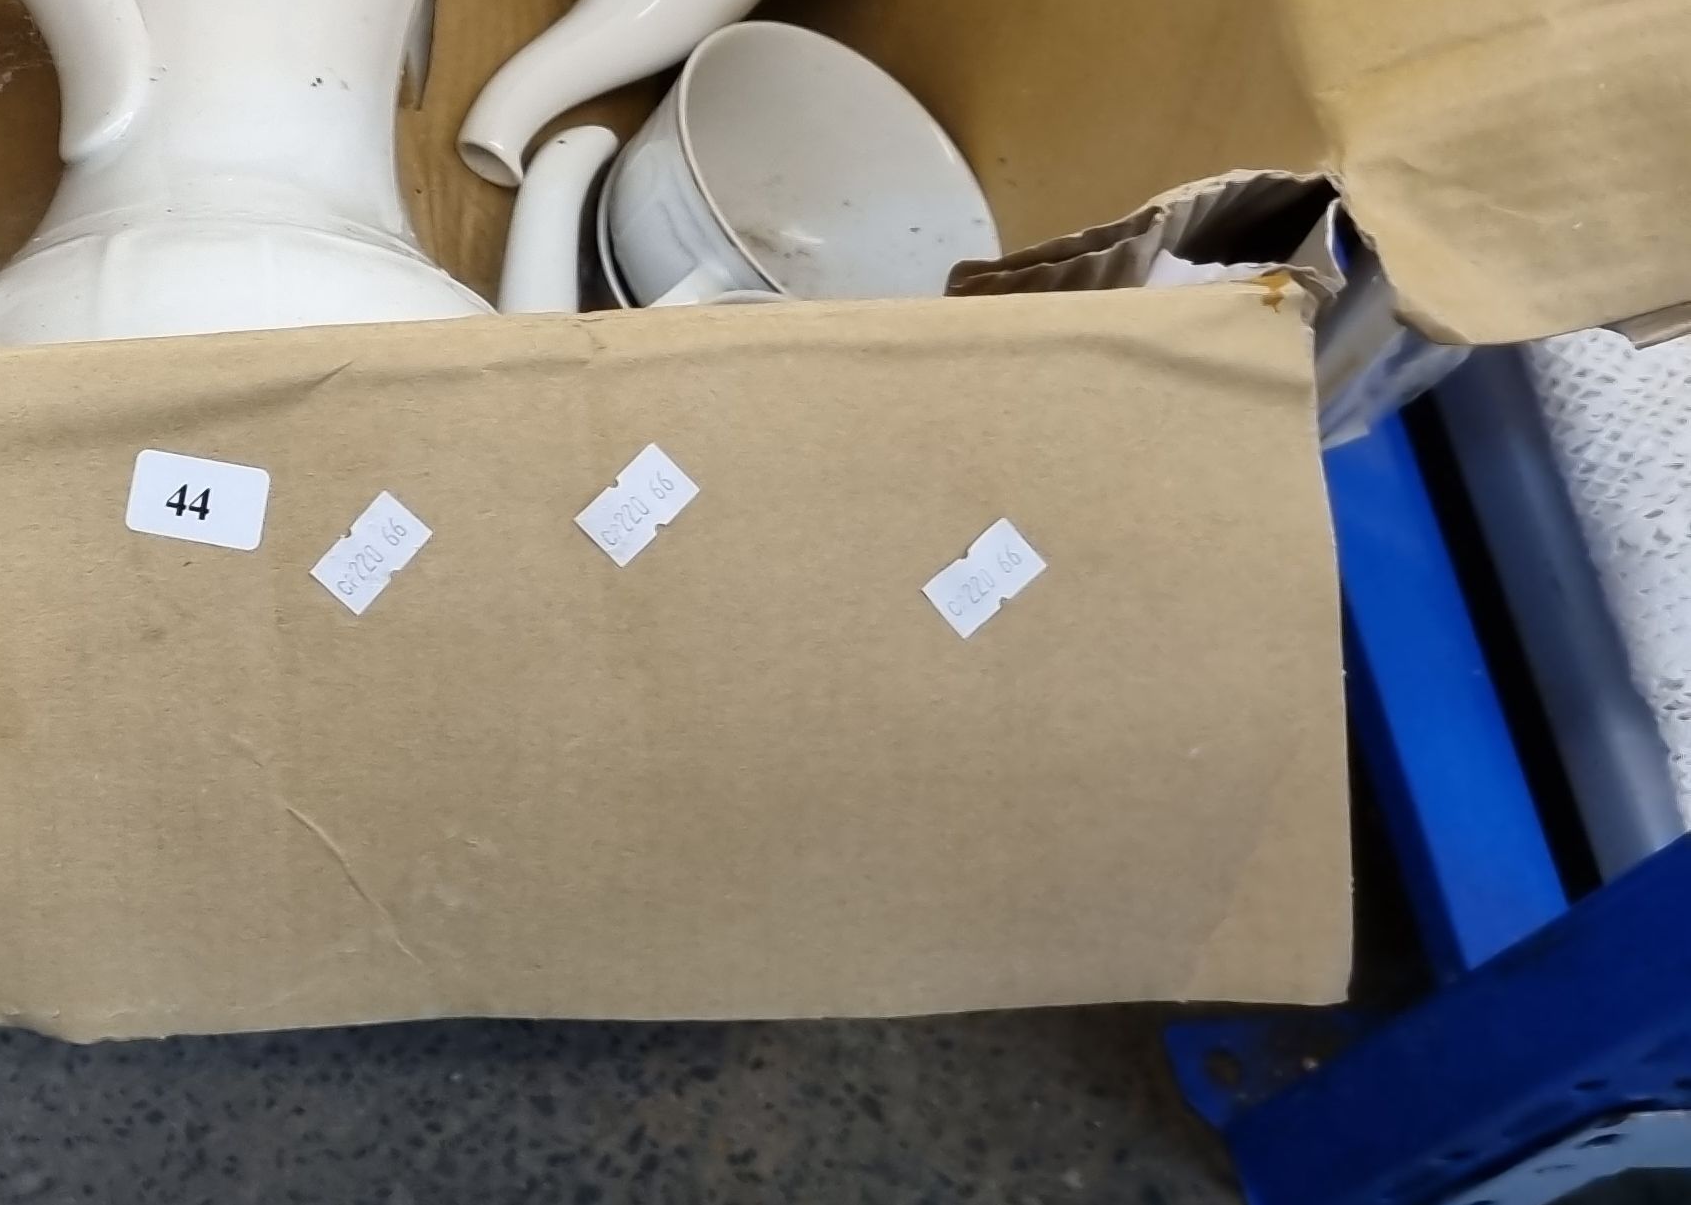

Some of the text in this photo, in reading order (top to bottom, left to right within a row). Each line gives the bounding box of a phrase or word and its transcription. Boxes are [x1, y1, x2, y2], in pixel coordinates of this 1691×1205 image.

[165, 483, 211, 521] 44
[649, 469, 676, 501] 66
[384, 516, 409, 548] 66
[947, 543, 1023, 617] C220 66
